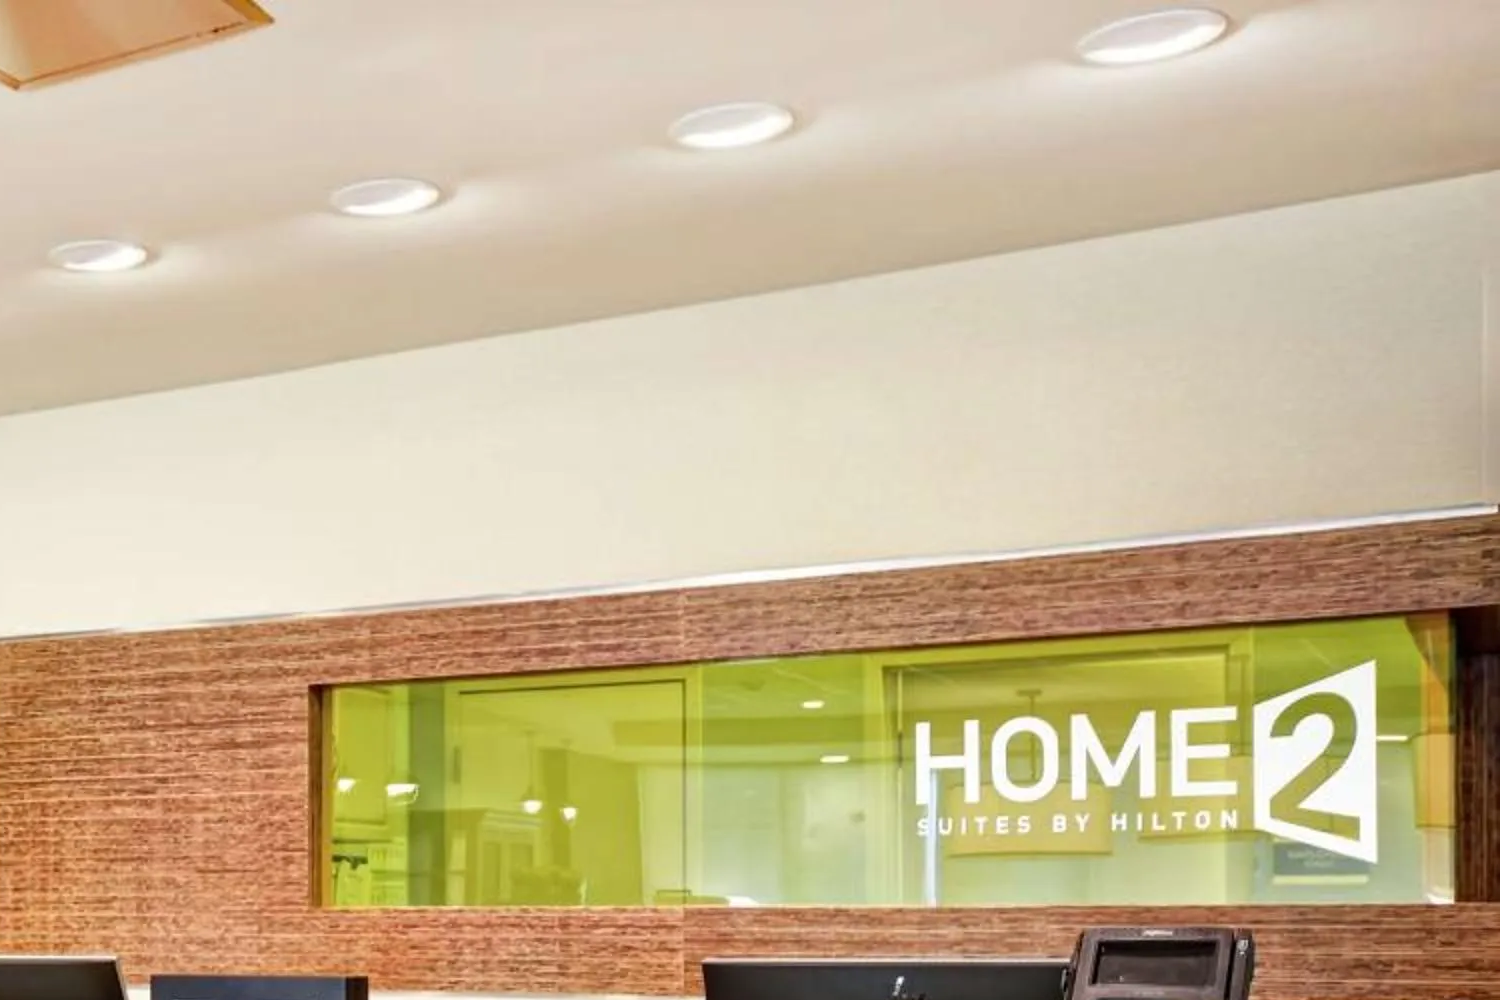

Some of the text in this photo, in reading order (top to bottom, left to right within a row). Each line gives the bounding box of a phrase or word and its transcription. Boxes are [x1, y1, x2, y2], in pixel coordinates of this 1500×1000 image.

[914, 686, 1365, 847] HOME 2
[917, 809, 1238, 836] SUITES BY HILTON
